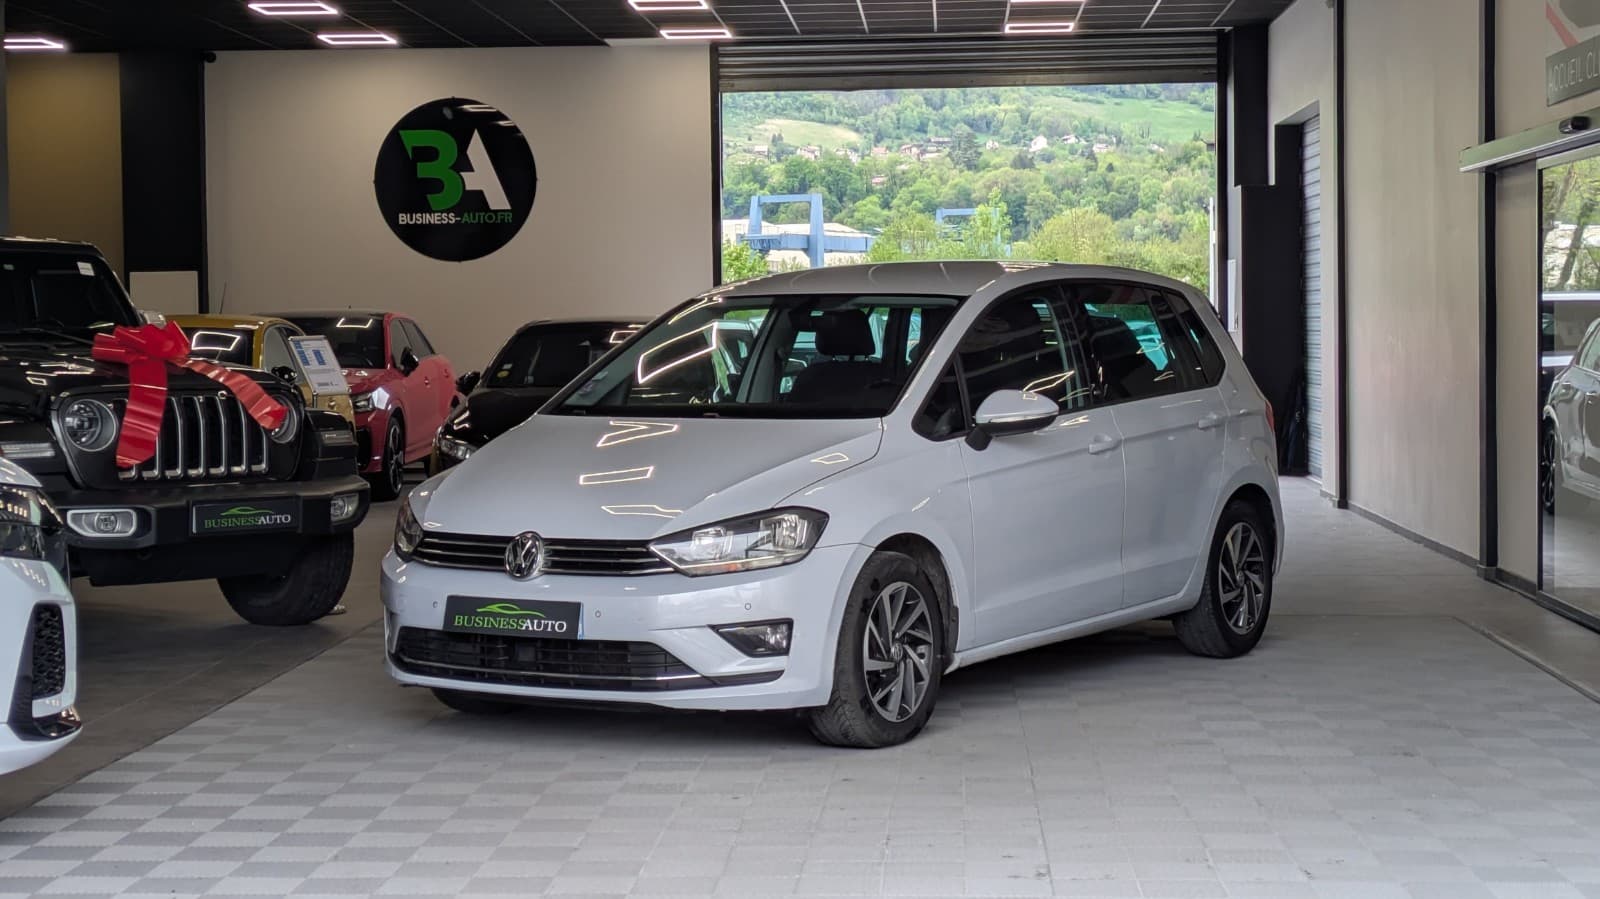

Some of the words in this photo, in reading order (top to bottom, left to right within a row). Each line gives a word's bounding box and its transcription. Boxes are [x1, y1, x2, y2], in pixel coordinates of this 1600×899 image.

[1548, 57, 1584, 92] ACCUEIL
[1586, 50, 1600, 79] CL
[398, 211, 513, 225] BUSINESS-AUTO.FR
